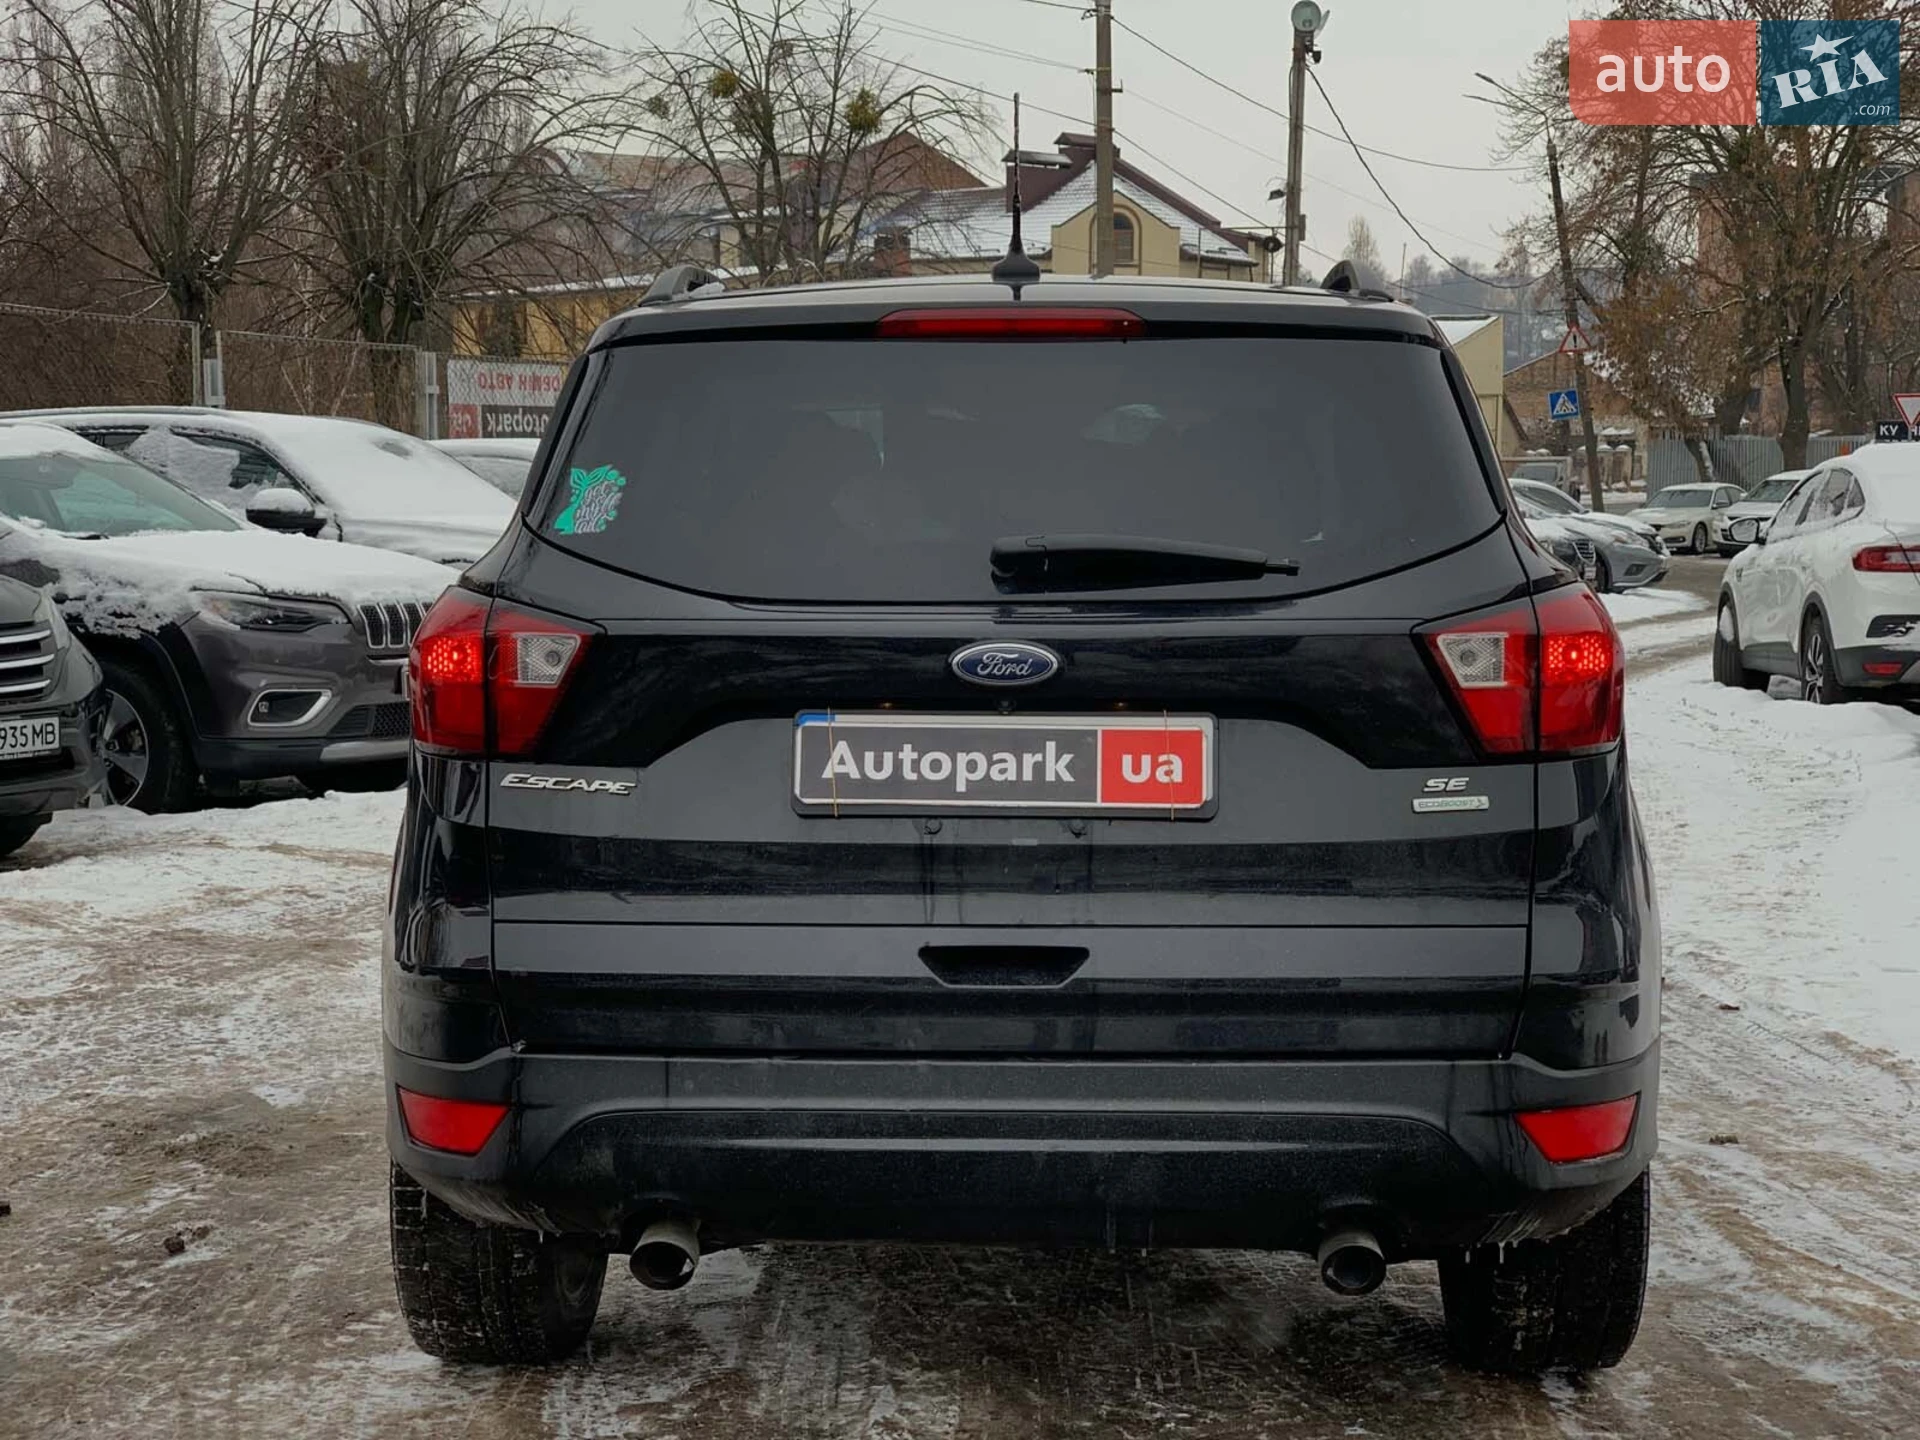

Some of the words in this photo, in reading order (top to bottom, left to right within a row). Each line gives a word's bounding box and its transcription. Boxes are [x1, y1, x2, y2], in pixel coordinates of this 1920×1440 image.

[487, 407, 549, 438] utopark
[977, 652, 1034, 676] Ford
[821, 740, 1076, 792] Autopark
[1121, 752, 1182, 783] ua
[500, 773, 636, 795] ESCAPE
[1423, 777, 1470, 792] SE
